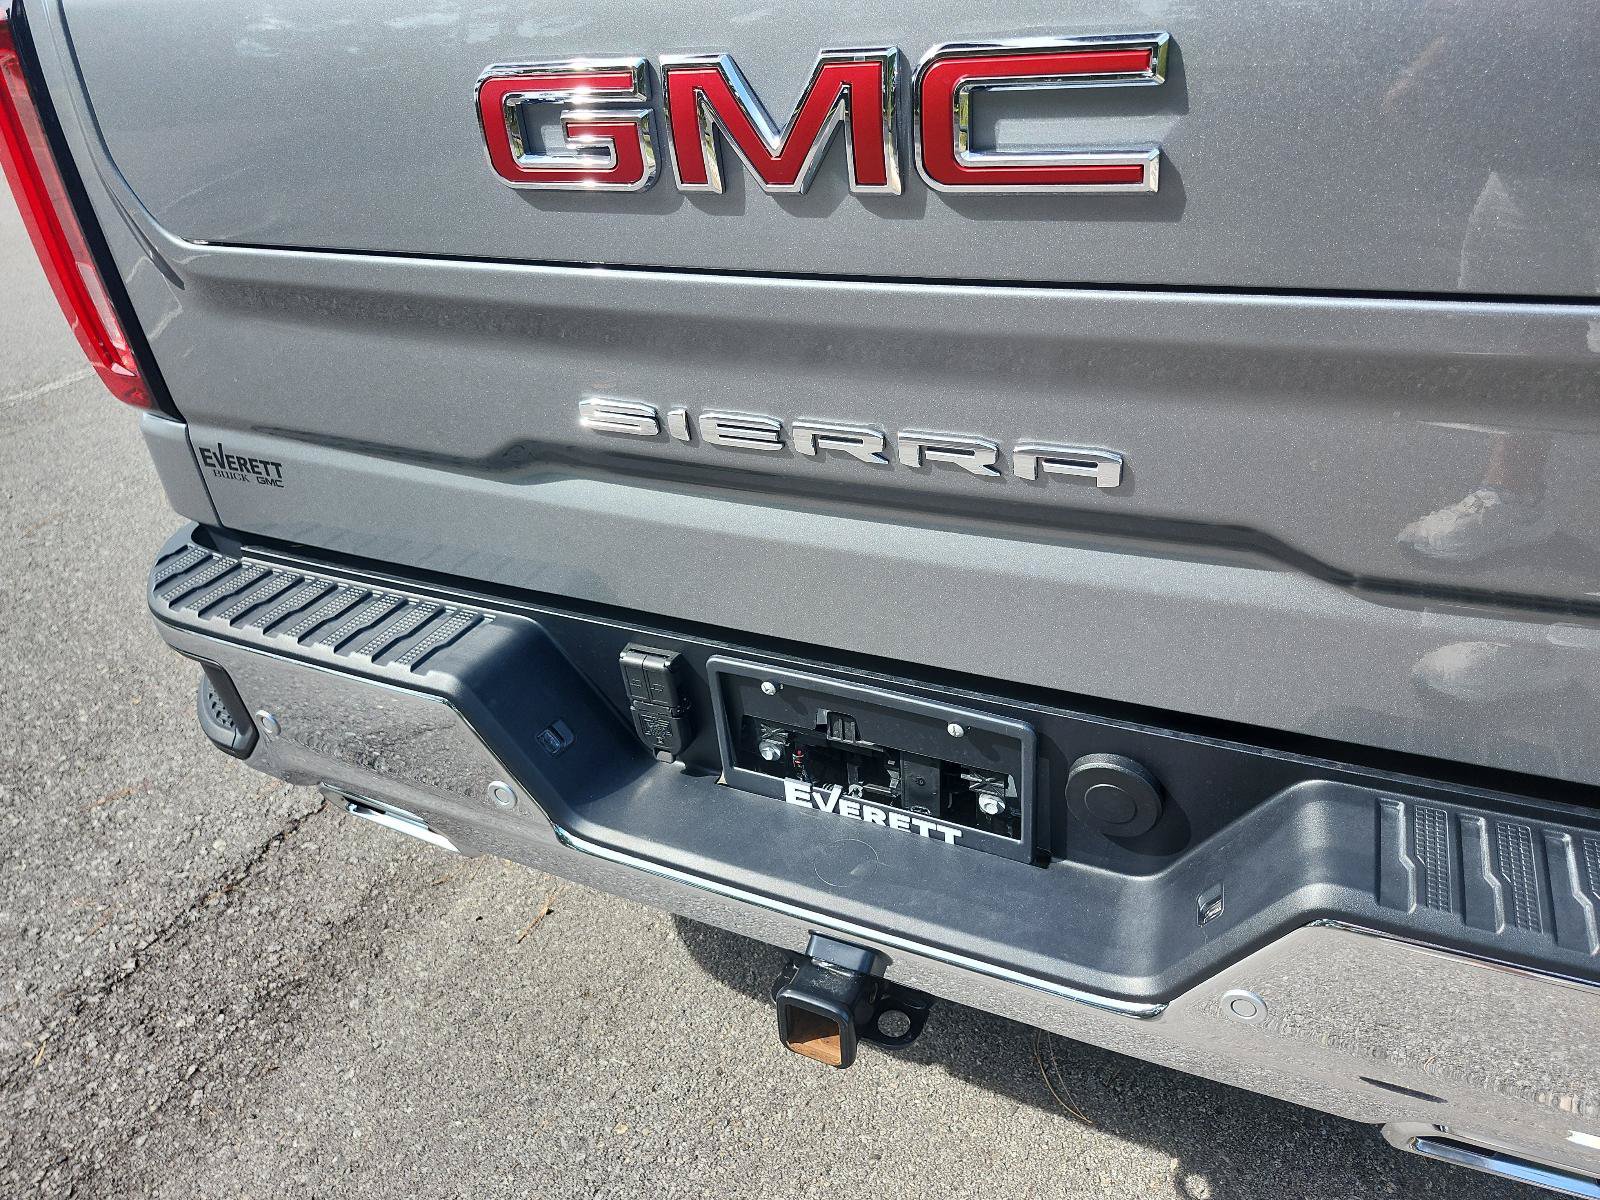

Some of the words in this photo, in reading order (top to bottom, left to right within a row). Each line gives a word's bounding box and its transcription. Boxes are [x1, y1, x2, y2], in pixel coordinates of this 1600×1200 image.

[474, 32, 1170, 195] GMC
[199, 443, 283, 478] EVERETT
[578, 397, 1124, 488] SIERRA
[213, 469, 250, 483] BUICK
[256, 476, 285, 488] GMC
[784, 777, 963, 845] EVERETT
